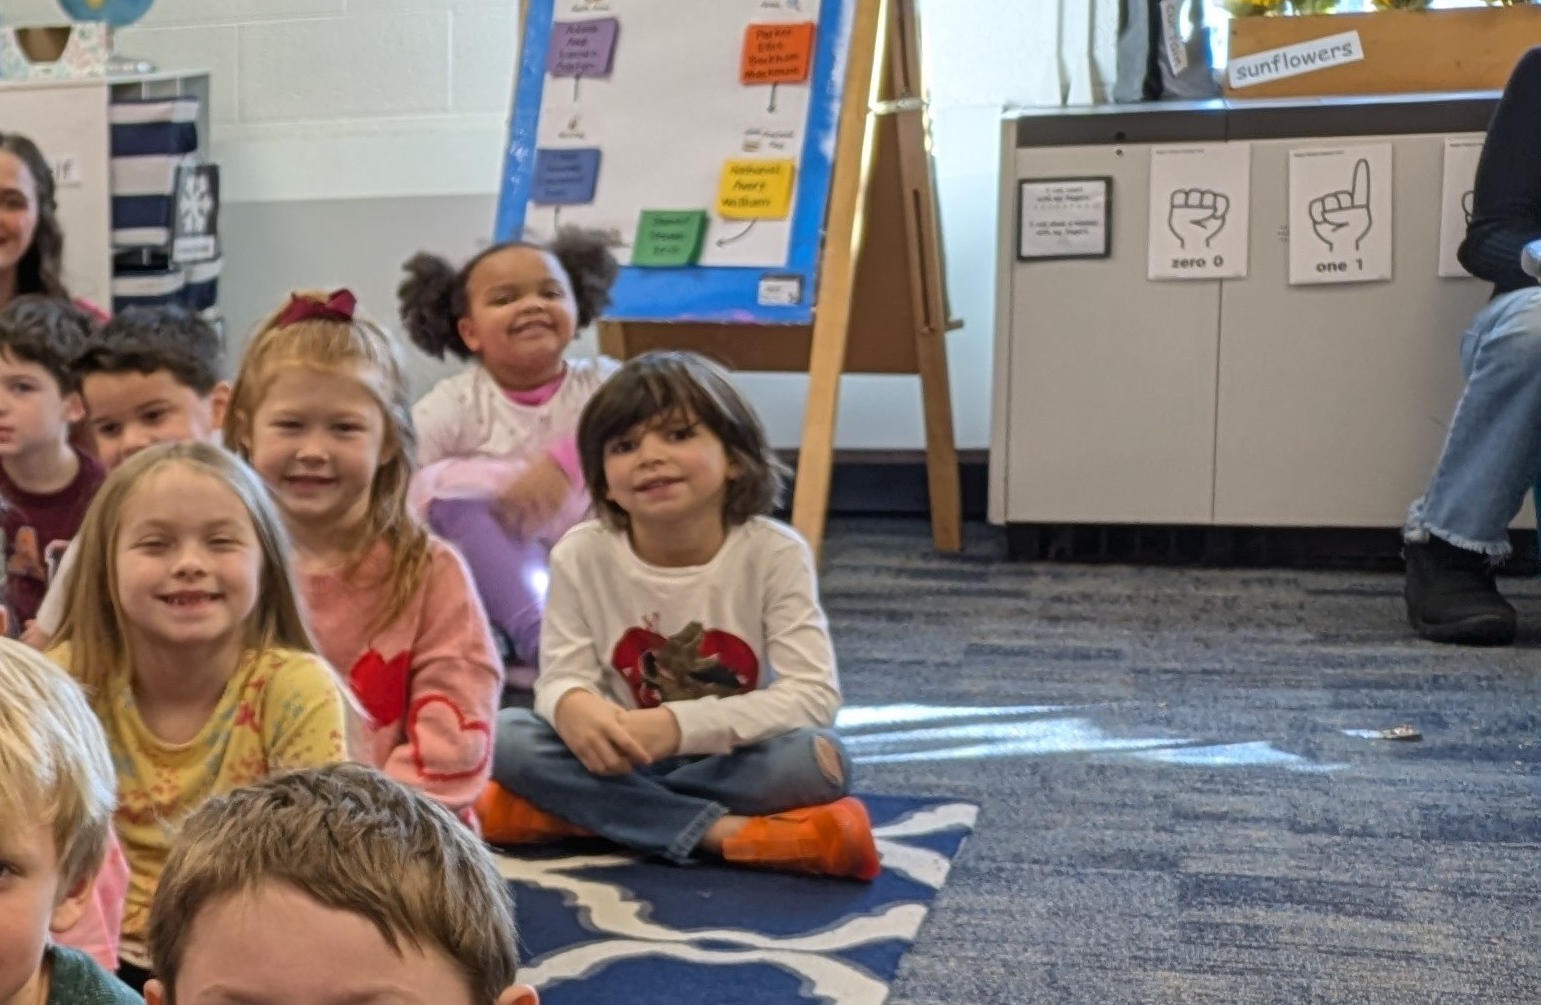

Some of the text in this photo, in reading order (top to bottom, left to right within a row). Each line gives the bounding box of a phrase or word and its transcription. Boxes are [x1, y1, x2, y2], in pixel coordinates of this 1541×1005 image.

[1236, 41, 1353, 81] sunflowers
[1172, 254, 1224, 268] zero 0
[1316, 258, 1363, 272] one 1
